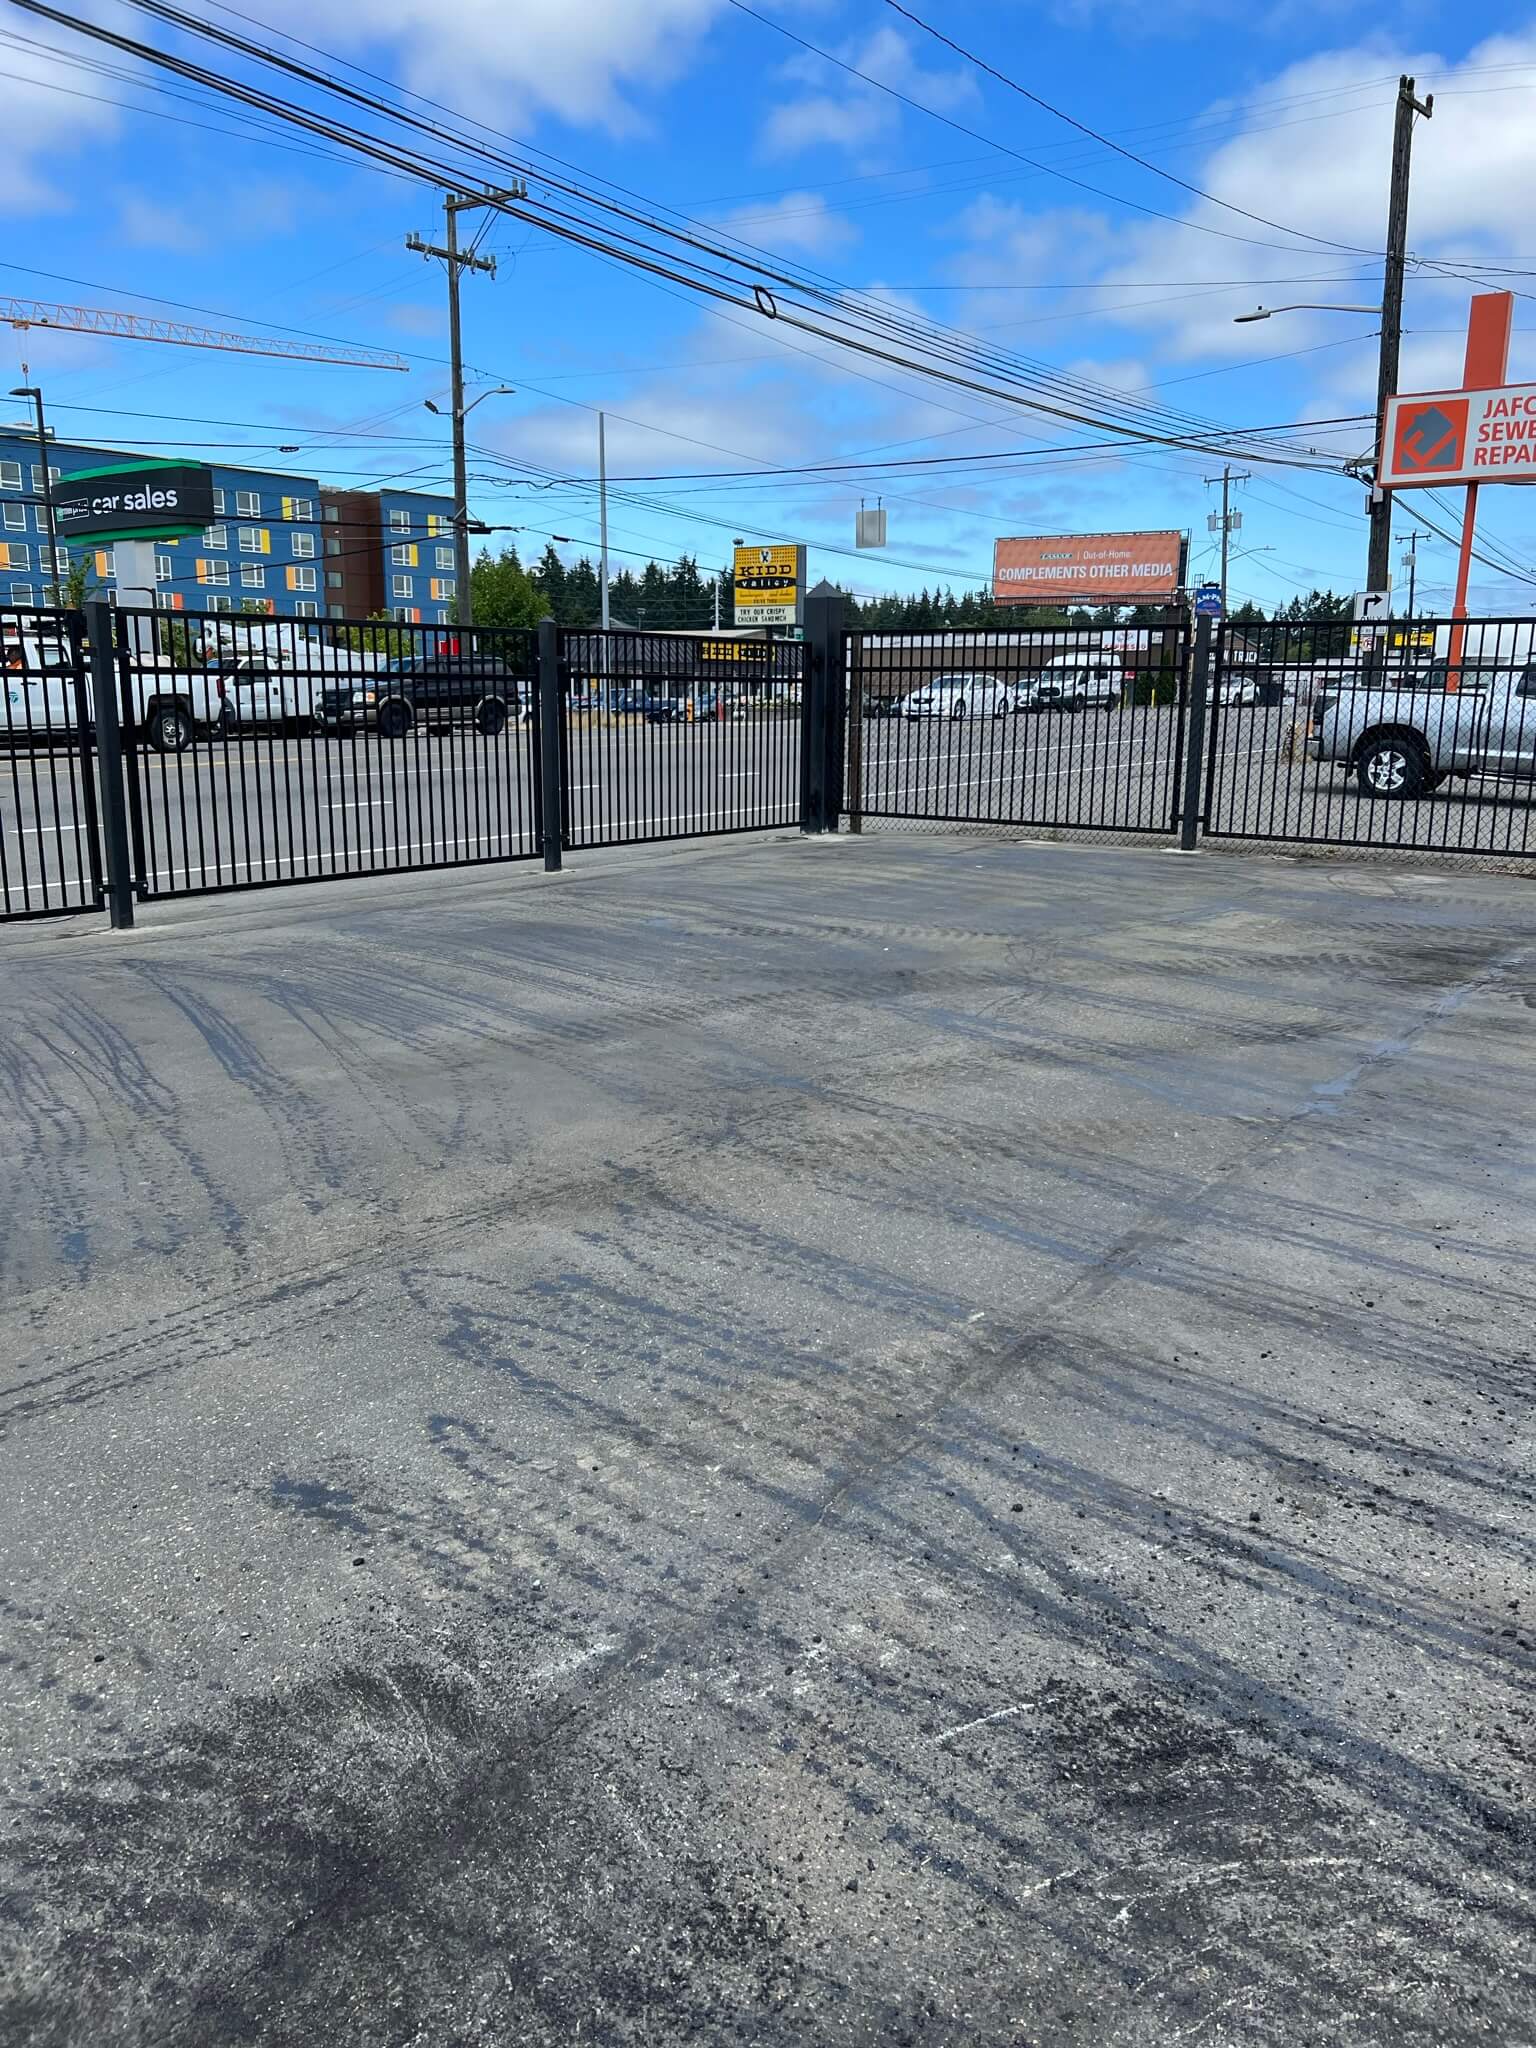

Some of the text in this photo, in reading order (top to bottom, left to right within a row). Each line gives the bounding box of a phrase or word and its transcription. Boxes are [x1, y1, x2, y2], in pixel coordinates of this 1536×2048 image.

[92, 495, 119, 515] car
[124, 484, 178, 511] sales
[739, 565, 791, 576] KIDD
[999, 565, 1086, 581] COMPLEMENTS
[1089, 564, 1128, 578] OTHER
